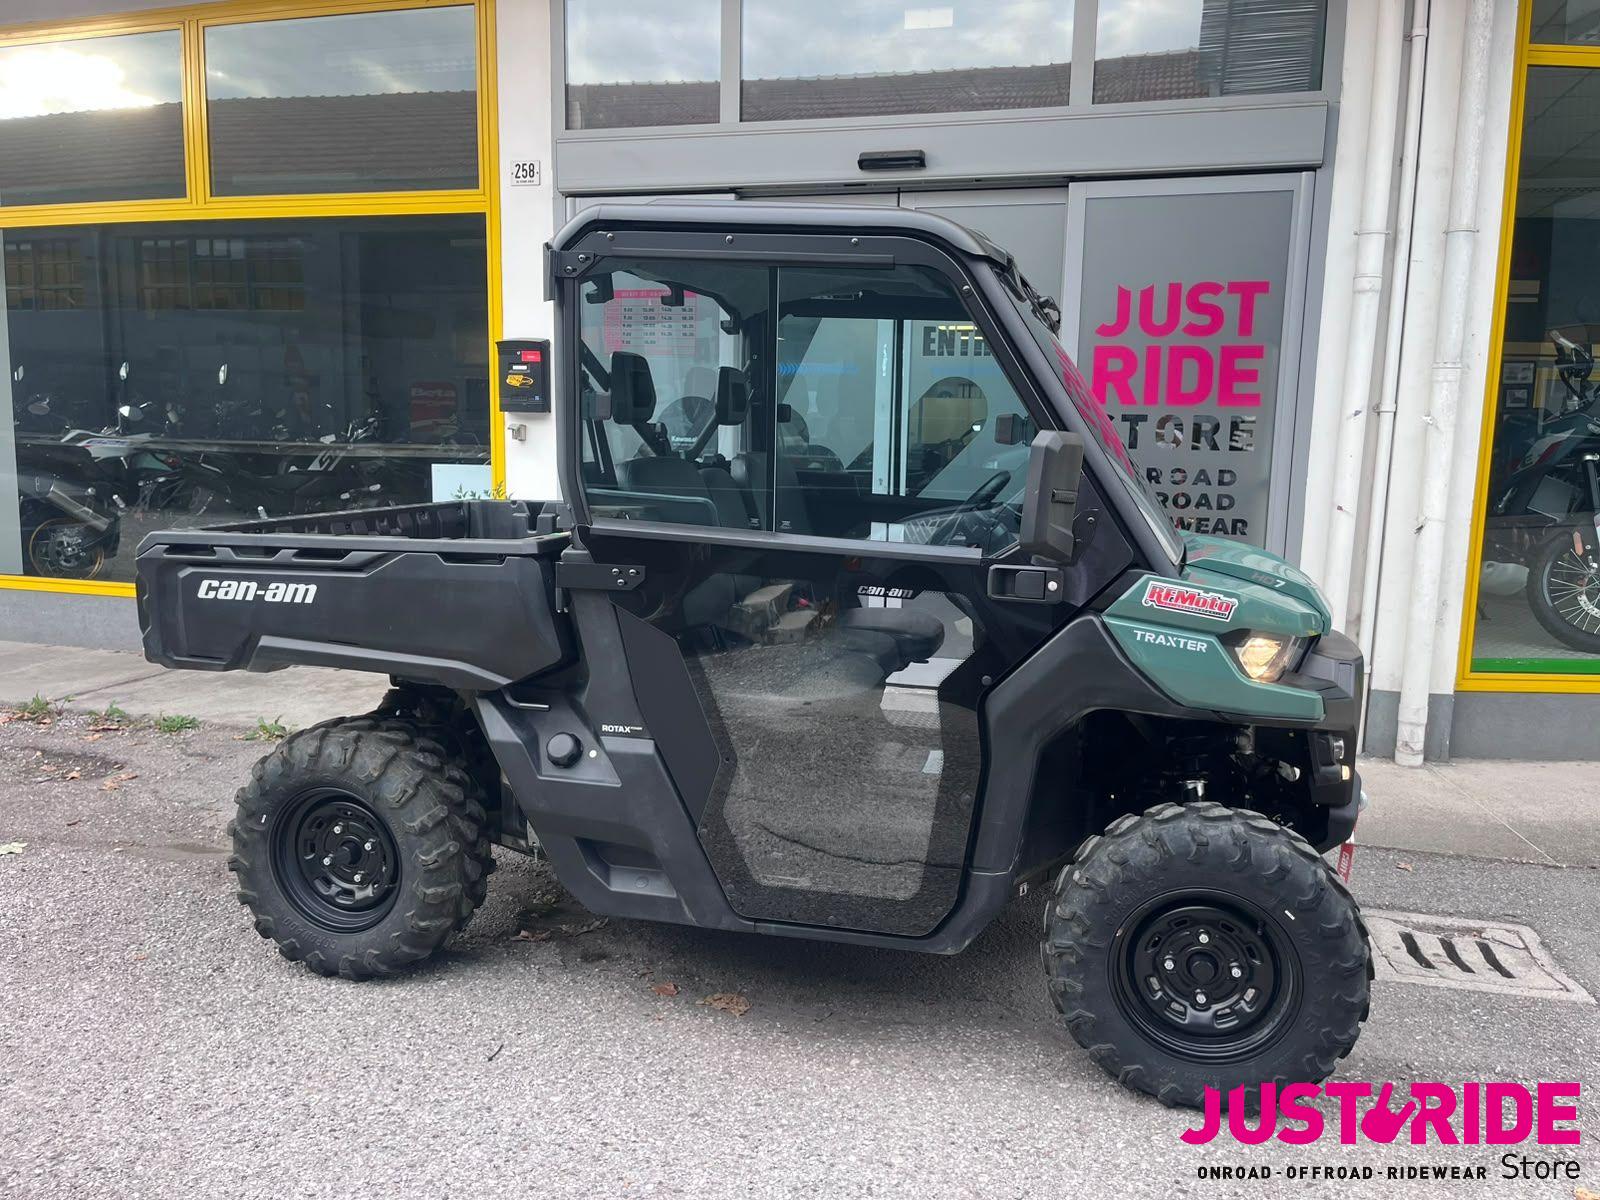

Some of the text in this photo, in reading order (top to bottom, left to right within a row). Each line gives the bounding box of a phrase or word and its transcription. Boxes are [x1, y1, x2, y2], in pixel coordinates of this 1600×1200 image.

[515, 162, 535, 179] 258
[1095, 281, 1271, 338] JUST
[1092, 345, 1265, 407] RIDE
[1108, 413, 1257, 451] TORE
[1145, 467, 1238, 487] ROAD
[1155, 491, 1236, 511] ROAD
[1169, 515, 1249, 536] WEAR
[197, 579, 318, 604] can-am
[857, 585, 914, 598] can-am
[1133, 629, 1208, 653] TRAXTER
[601, 724, 631, 733] ROTAX
